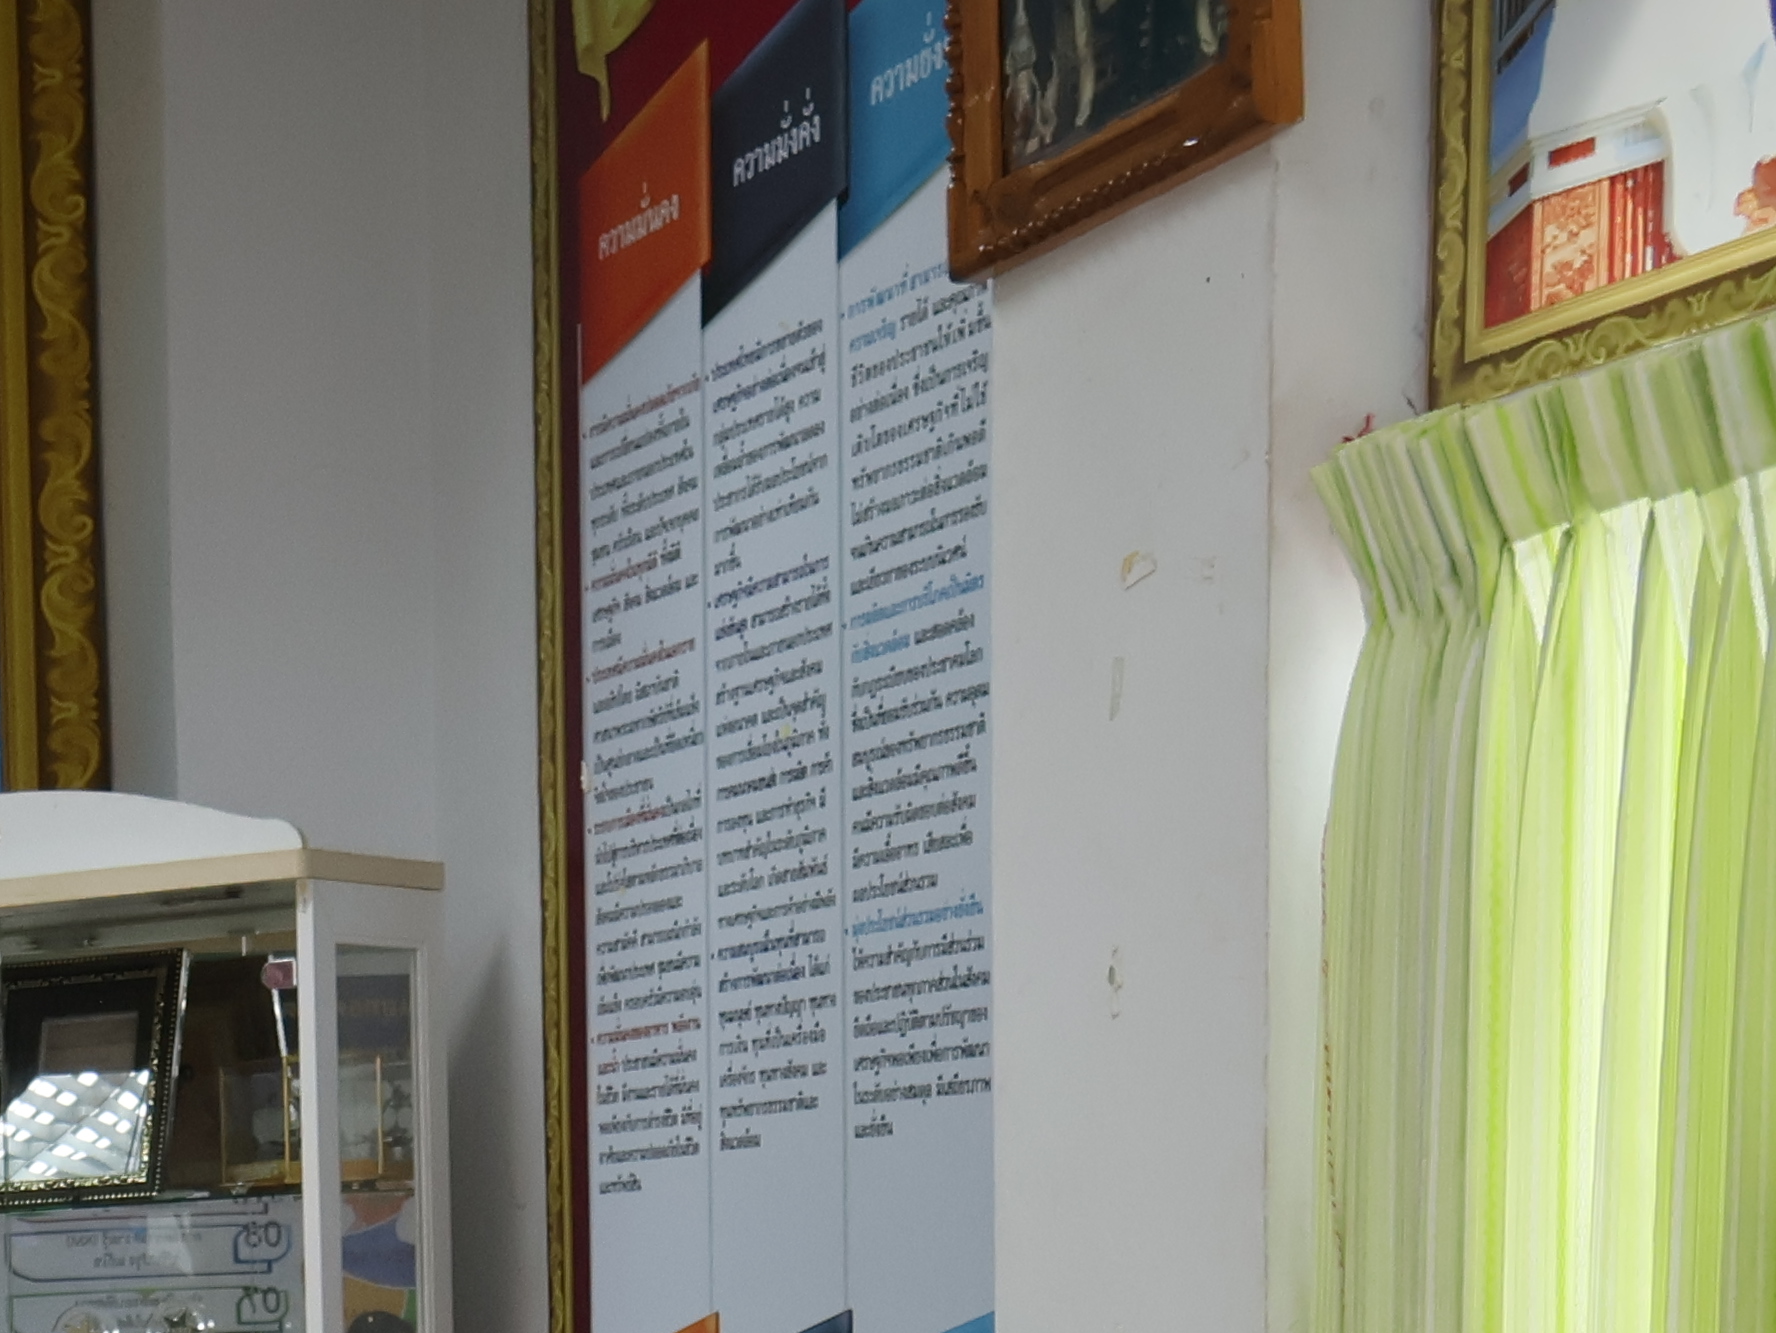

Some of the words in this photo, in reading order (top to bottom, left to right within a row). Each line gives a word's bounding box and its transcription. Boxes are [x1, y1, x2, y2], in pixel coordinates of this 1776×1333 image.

[733, 88, 822, 187] ความมั่งคั่ง
[599, 182, 680, 260] ความมั่นคง
